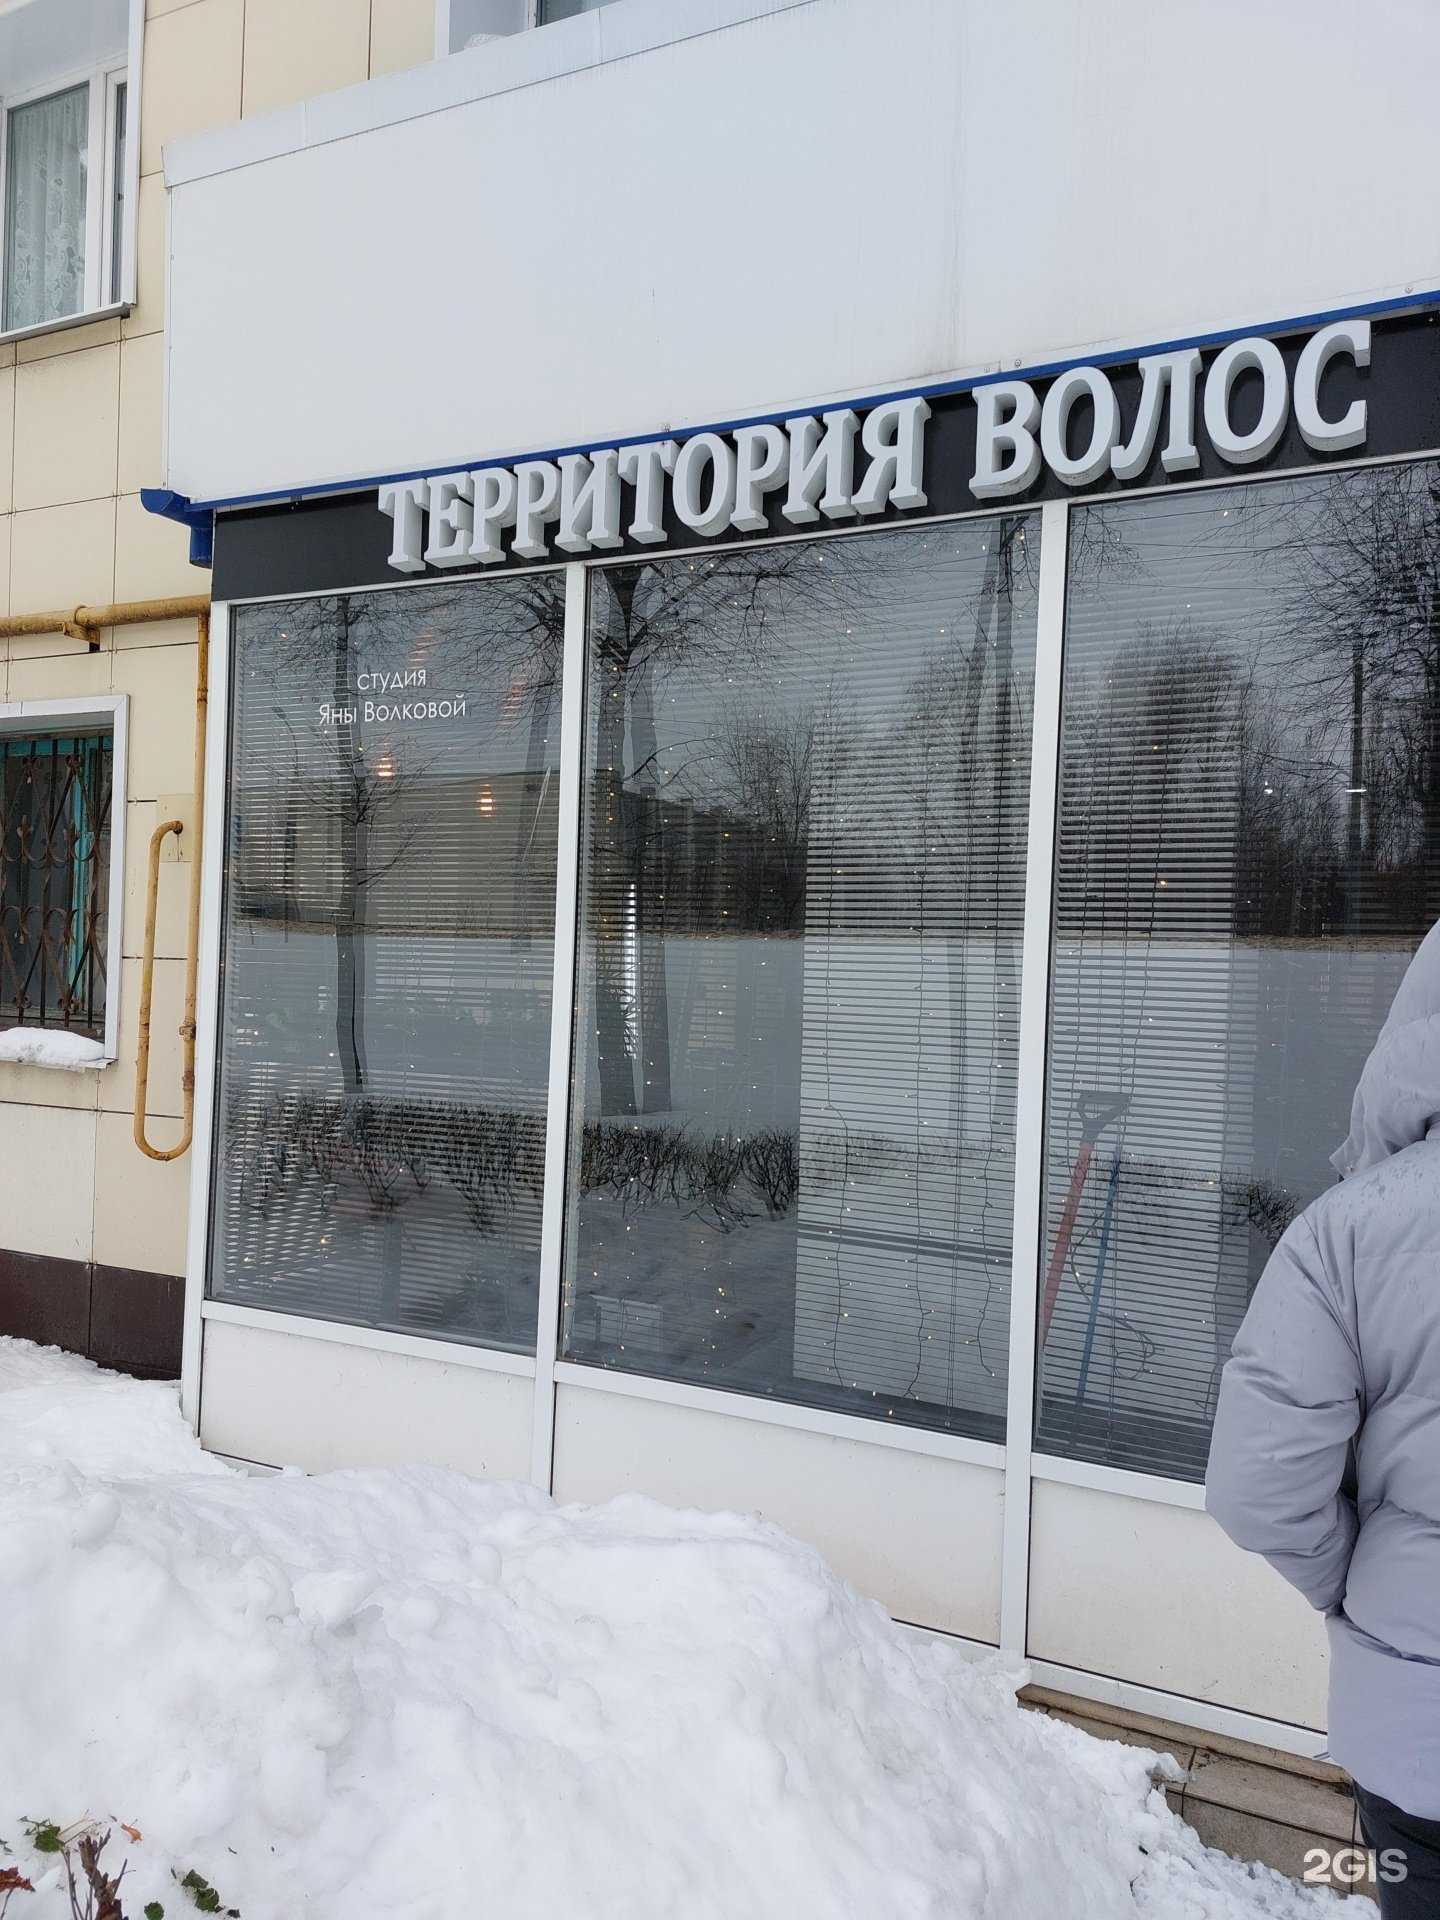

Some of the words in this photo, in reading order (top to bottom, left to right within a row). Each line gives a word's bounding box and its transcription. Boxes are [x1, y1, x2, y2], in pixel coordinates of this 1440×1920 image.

[378, 396, 931, 572] ТЕРРИТОРИЯ
[968, 320, 1371, 499] ВОЛОС
[357, 669, 426, 694] студия
[319, 703, 357, 725] Яны
[364, 693, 466, 722] Волковой
